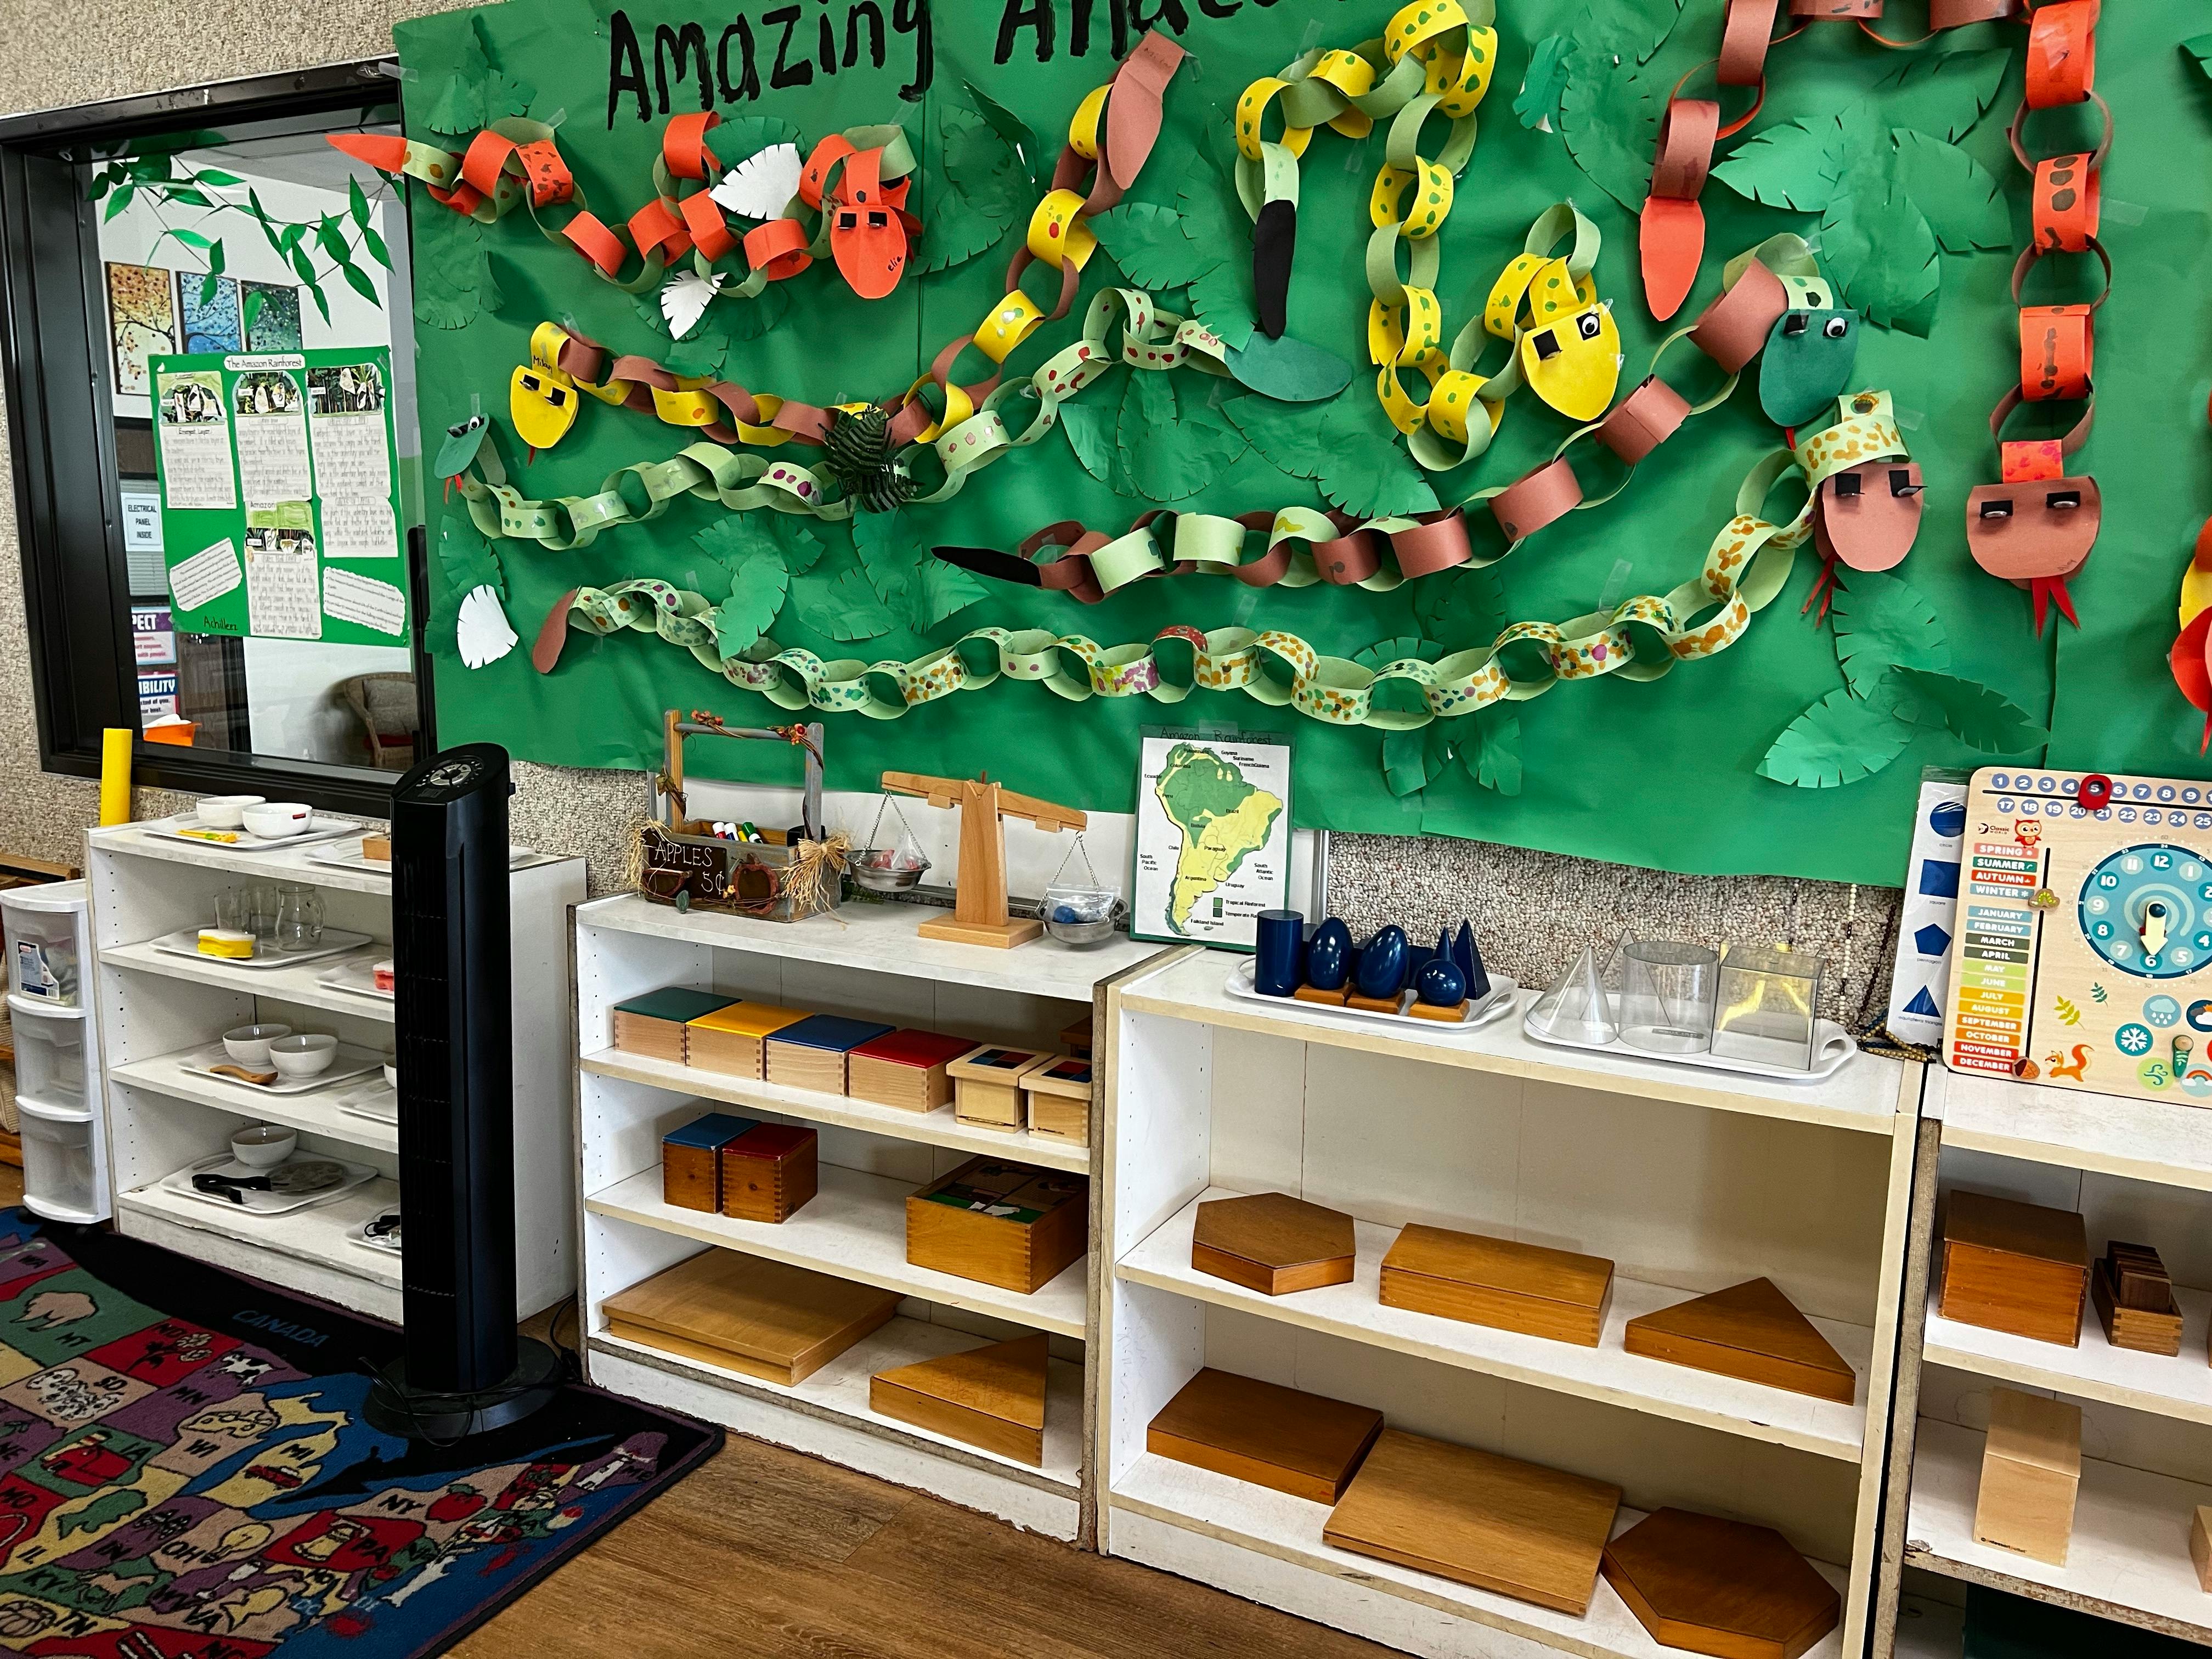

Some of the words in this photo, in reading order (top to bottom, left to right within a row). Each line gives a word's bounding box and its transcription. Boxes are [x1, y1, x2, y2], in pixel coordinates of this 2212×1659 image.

[607, 0, 934, 132] Amazing
[227, 357, 240, 368] The
[241, 360, 267, 368] Amazon
[268, 356, 302, 368] Rainforest
[533, 355, 552, 374] Milan
[132, 614, 157, 630] PECT
[138, 679, 176, 695] IBILITY
[1160, 727, 1200, 741] Amazon
[1212, 730, 1272, 745] Rainforest
[1997, 777, 2004, 786] 1
[2018, 778, 2029, 787] 2
[2042, 780, 2052, 789] 3
[2066, 782, 2075, 791] 4
[2090, 784, 2100, 793] 5
[2113, 786, 2123, 794] 6
[2138, 787, 2147, 796] 7
[2162, 789, 2171, 798] 8
[2186, 791, 2197, 800] 9
[1999, 800, 2015, 810] 17
[2023, 803, 2038, 812] 18
[2046, 804, 2062, 814] 19
[2070, 806, 2086, 816] 20
[2096, 809, 2110, 817] 21
[2120, 810, 2136, 820] 22
[2145, 812, 2160, 822] 23
[2170, 814, 2185, 823] 24
[2195, 816, 2211, 826] 25
[654, 841, 713, 867] APPLES
[1979, 845, 2023, 856] SPRING
[1977, 858, 2025, 871] SUMMER
[2127, 858, 2138, 870] 11
[2154, 855, 2170, 868] 12
[2188, 865, 2193, 877] 1
[1976, 872, 2024, 884] AUTUMN
[2101, 875, 2117, 887] 10
[1976, 885, 2018, 897] WINTER
[2093, 899, 2104, 911] 9
[1978, 909, 2023, 919] JANUARY
[1974, 922, 2024, 934] FEBRUARY
[2097, 924, 2108, 936] 8
[1980, 936, 2015, 947] MARCH
[2198, 934, 2210, 947] 4
[1981, 950, 2011, 960] APRIL
[2117, 945, 2128, 956] 7
[2176, 951, 2188, 962] 5
[2145, 955, 2157, 967] 6
[1984, 964, 2005, 973] MAY
[1980, 978, 2005, 987] JUNE
[1980, 991, 2004, 1000] JULY
[1972, 1004, 2010, 1015] AUGUST
[1898, 1015, 1924, 1024] equilateral
[1961, 1016, 2017, 1030] SEPTEMBER
[1966, 1031, 2010, 1043] OCTOBER
[1960, 1044, 2012, 1058] NOVEMBER
[1960, 1057, 2010, 1071] DECEMBER
[156, 1322, 188, 1338] ND
[232, 1310, 329, 1347] CANADA
[55, 1331, 92, 1348] MT
[93, 1375, 128, 1392] SD
[166, 1386, 212, 1405] MN
[119, 1441, 153, 1462] IA
[183, 1438, 221, 1458] WI
[279, 1443, 317, 1462] MI
[377, 1493, 426, 1515] NY
[16, 1545, 48, 1565] IL
[93, 1540, 133, 1562] IN
[161, 1541, 207, 1564] OH
[350, 1537, 389, 1562] PA
[23, 1568, 68, 1592] KY
